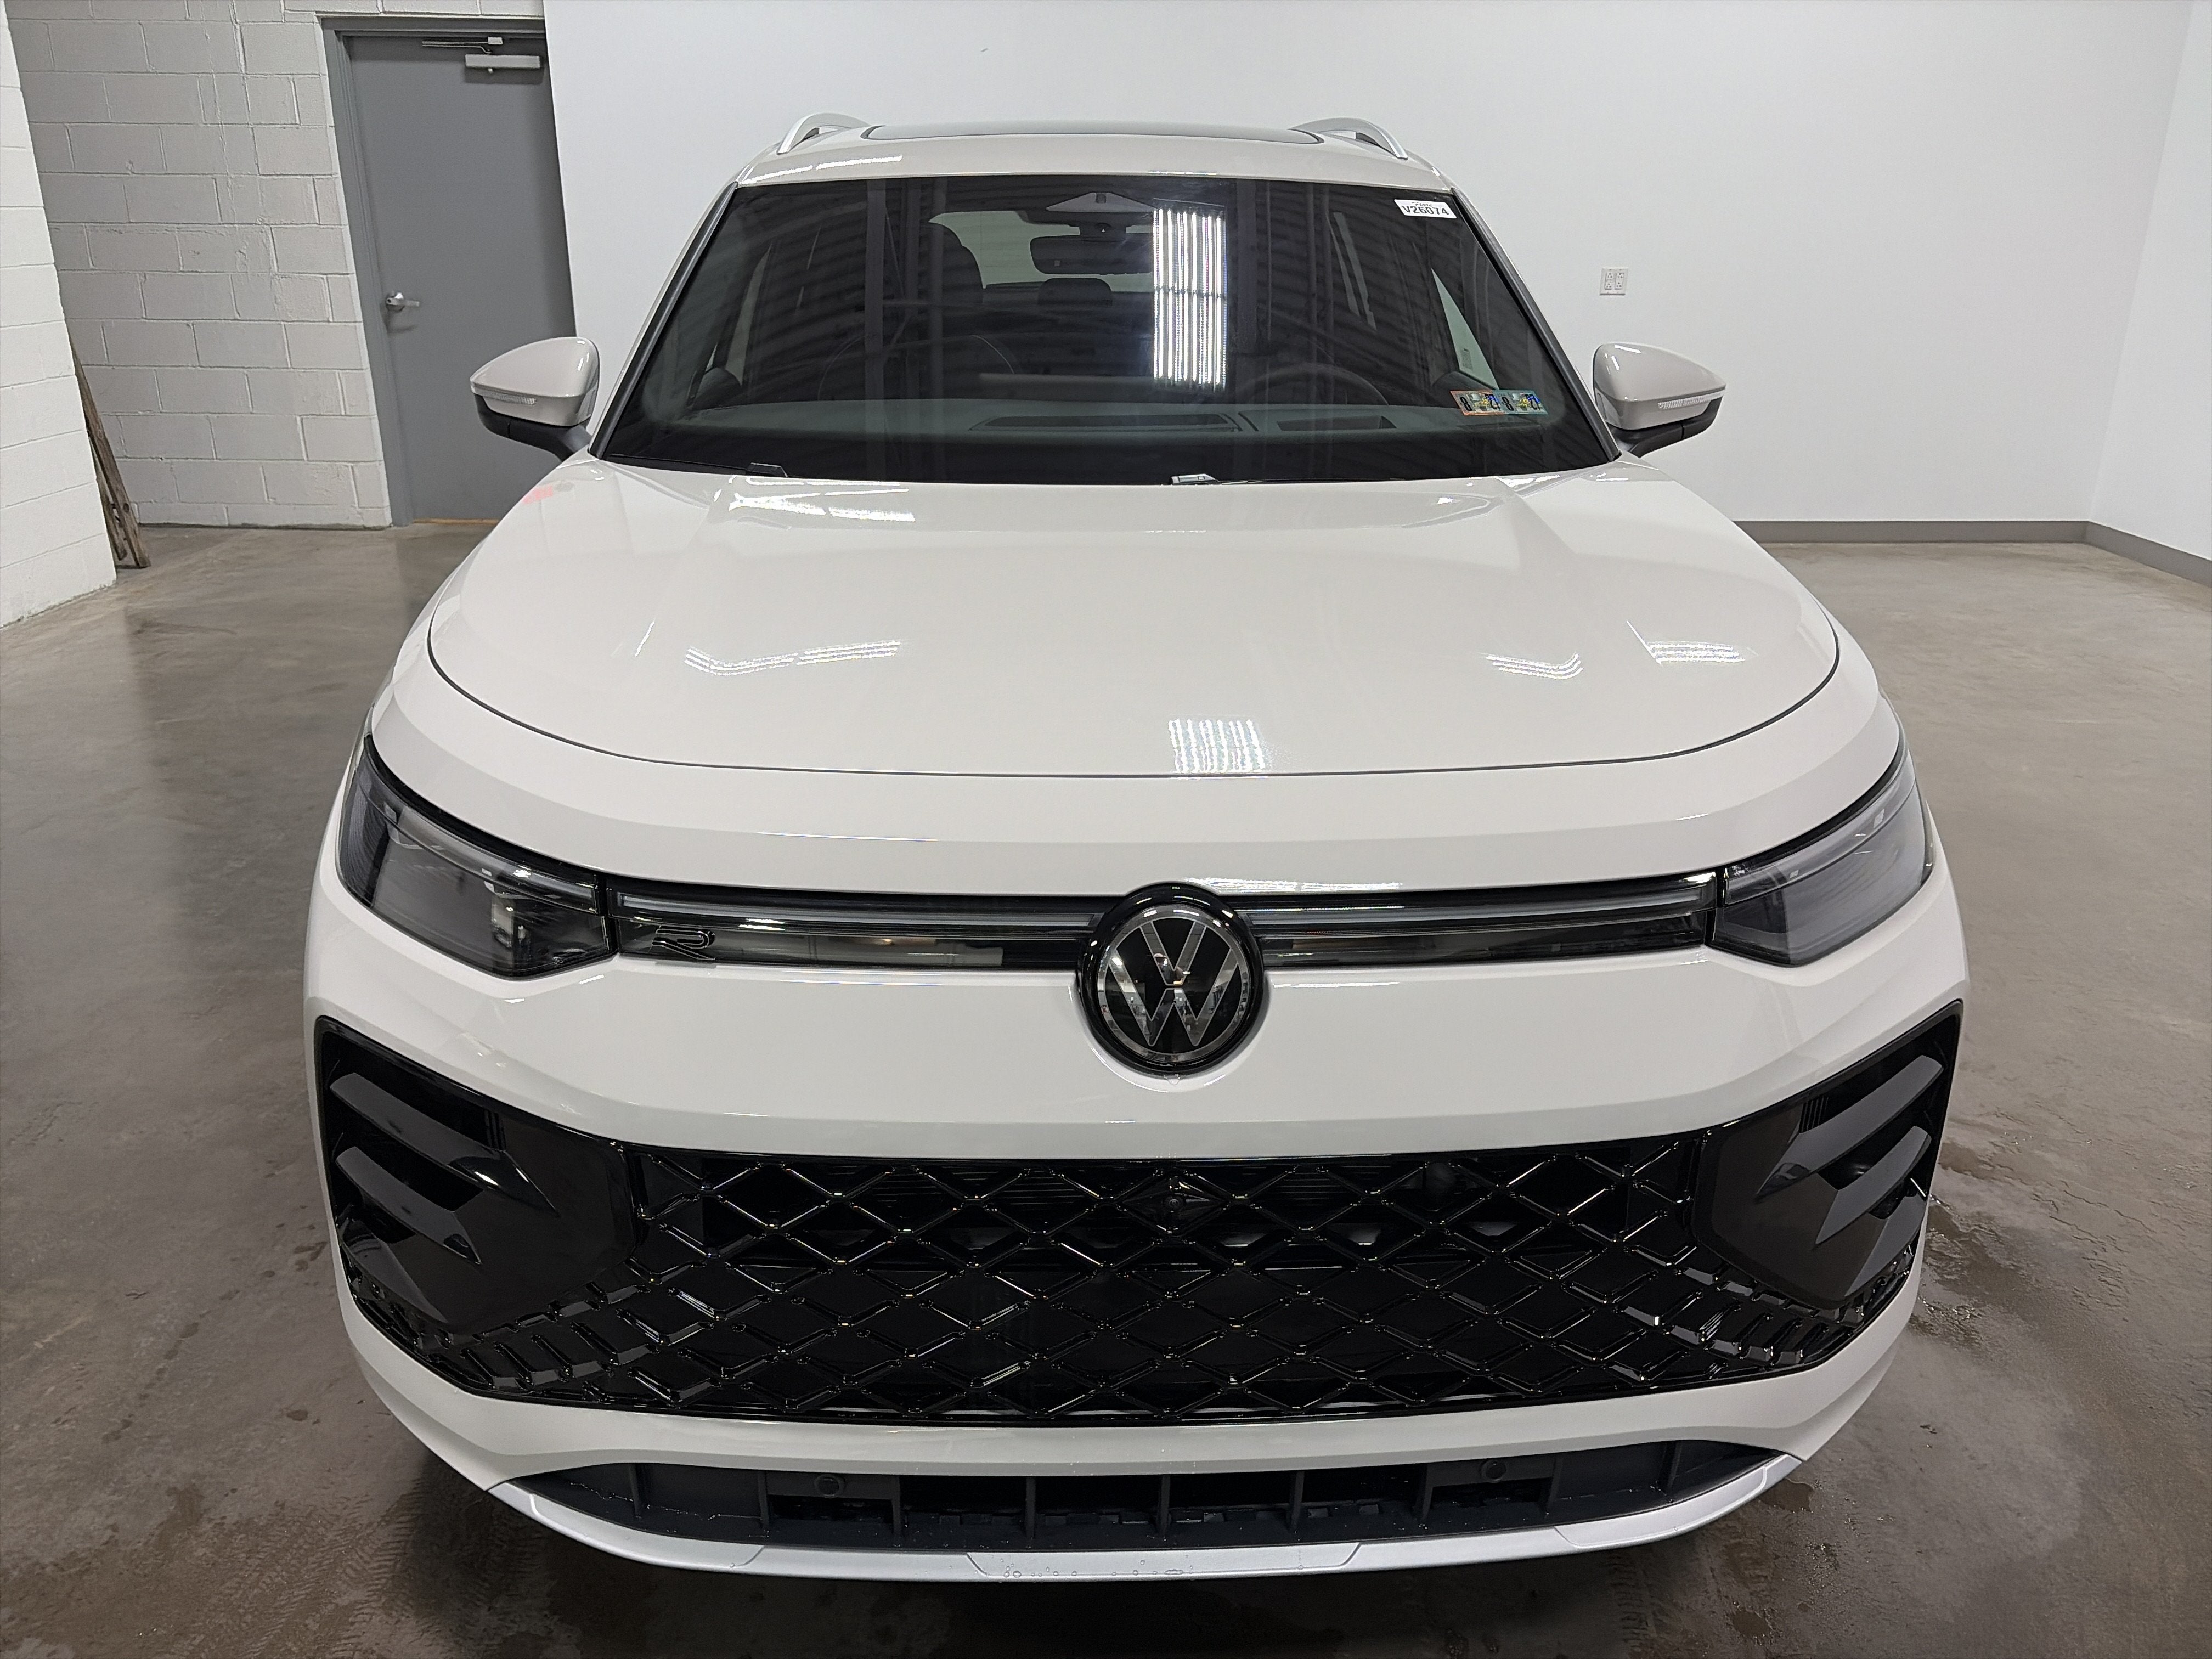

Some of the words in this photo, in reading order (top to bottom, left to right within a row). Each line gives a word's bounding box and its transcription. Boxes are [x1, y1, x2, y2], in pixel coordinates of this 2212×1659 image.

[1401, 205, 1449, 215] V26074
[1460, 397, 1472, 411] 8
[1502, 397, 1515, 411] 8
